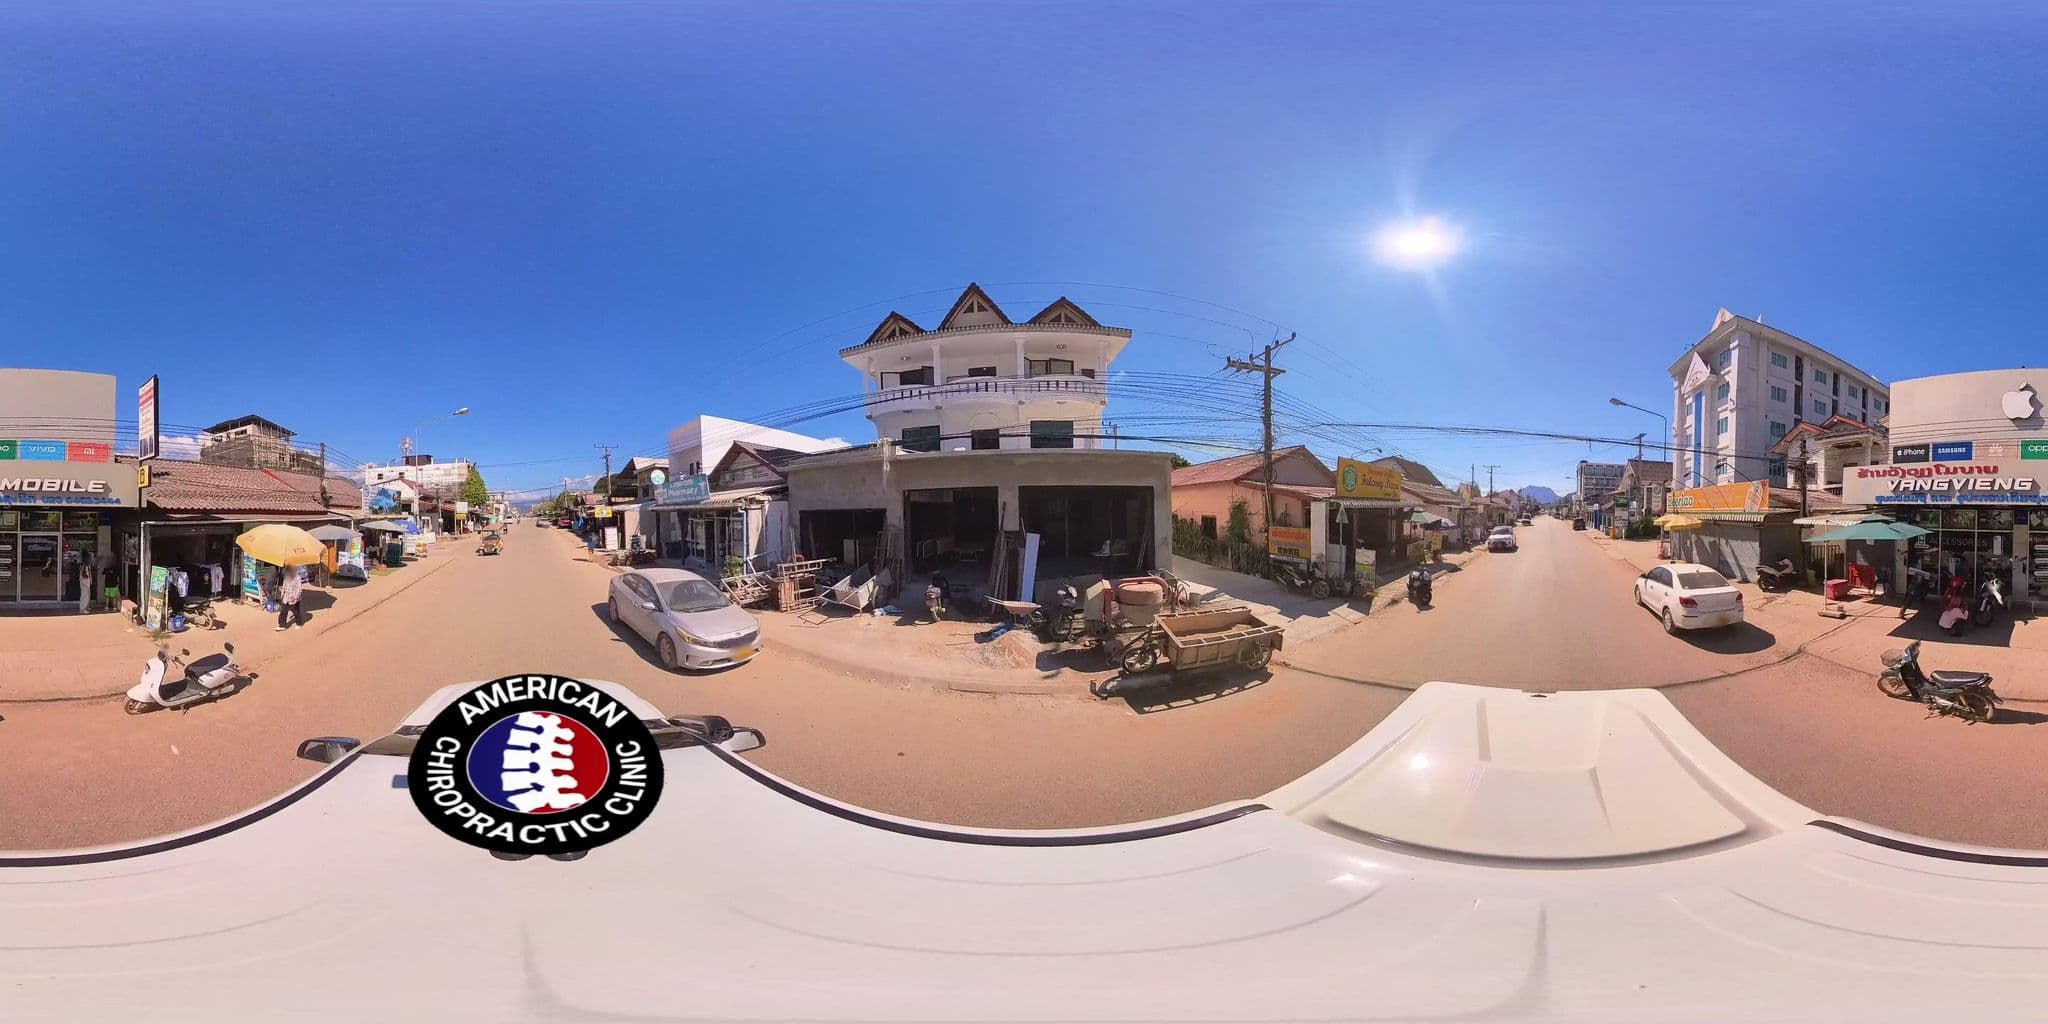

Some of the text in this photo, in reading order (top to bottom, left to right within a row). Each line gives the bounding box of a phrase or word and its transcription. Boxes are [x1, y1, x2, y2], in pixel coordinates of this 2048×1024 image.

[1937, 446, 1967, 454] SAMSUNG
[0, 477, 107, 493] MOBILE
[1886, 477, 2034, 492] VANGVIENG
